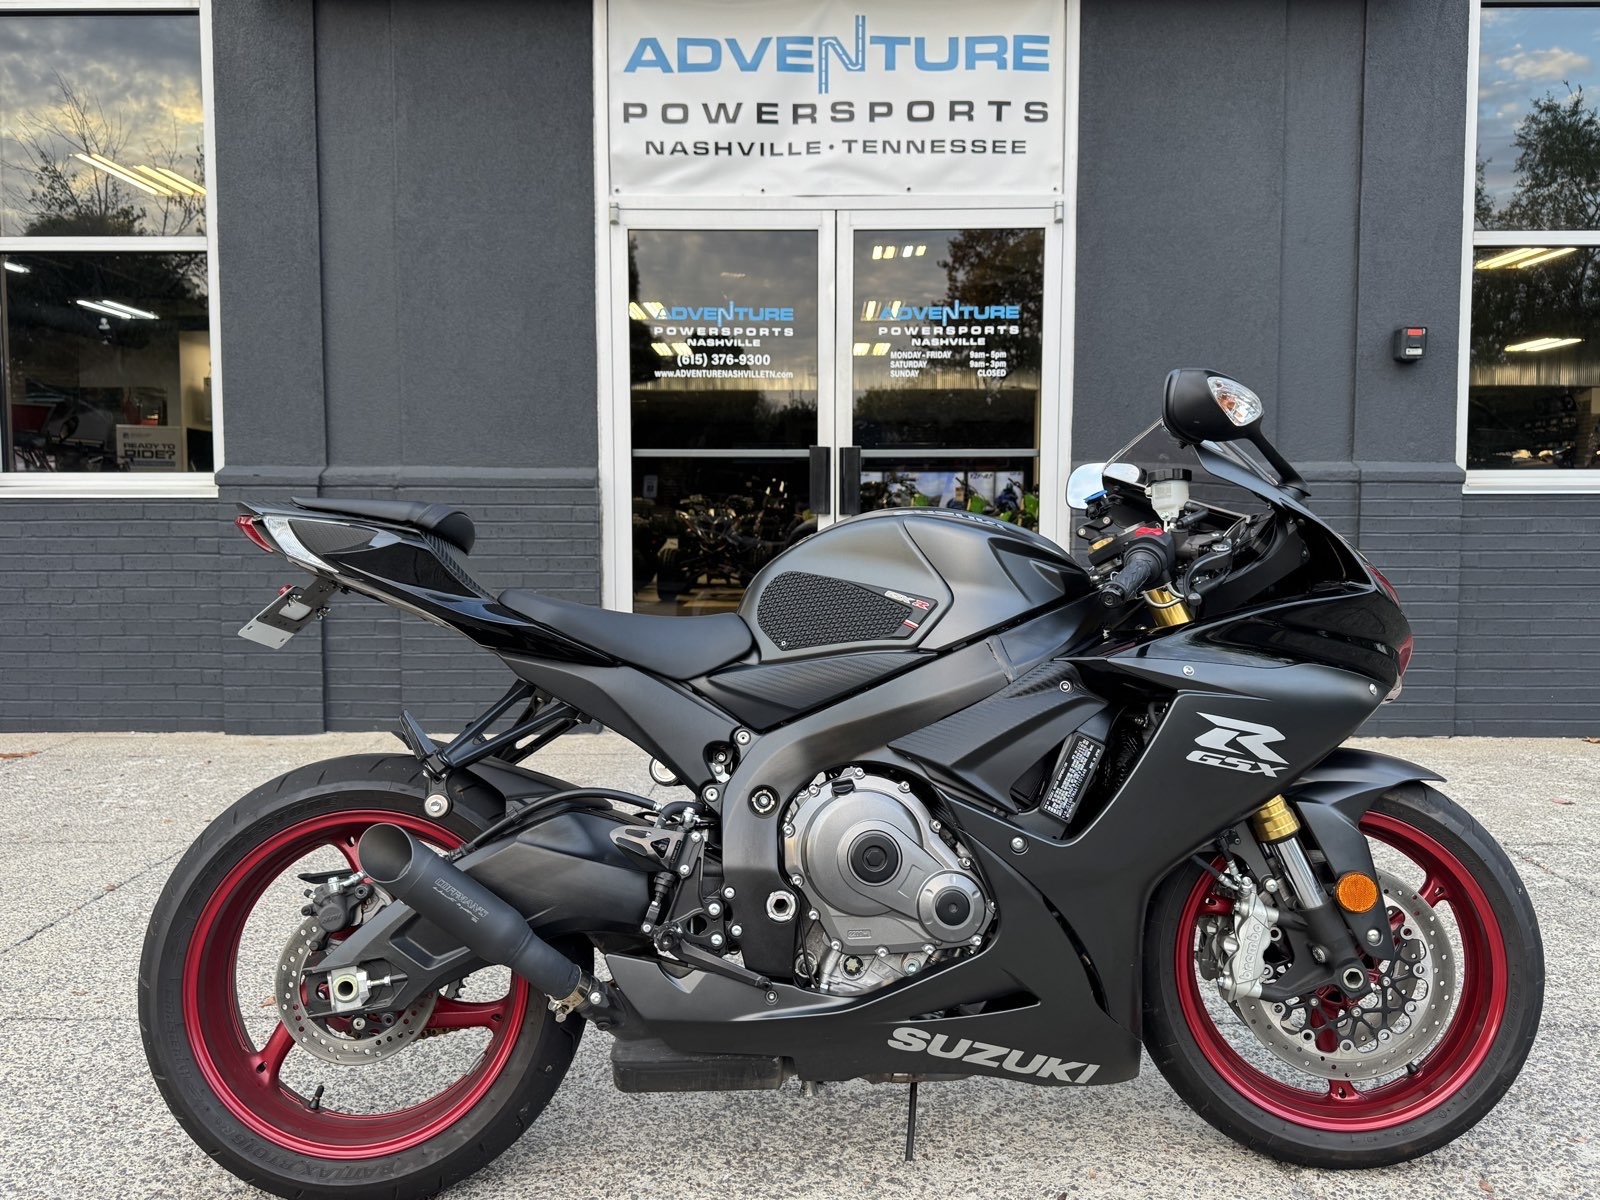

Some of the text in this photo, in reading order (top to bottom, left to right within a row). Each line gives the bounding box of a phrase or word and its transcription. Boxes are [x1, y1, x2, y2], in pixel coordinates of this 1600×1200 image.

[623, 15, 1050, 94] ADVENTURE
[623, 100, 1049, 125] POWERSPORTS
[645, 139, 1027, 157] NASHVILLE TENNESSEE
[656, 301, 794, 327] ADVENTURE
[879, 300, 1020, 326] ADVENTURE
[654, 327, 794, 337] POWERSPORTS
[878, 326, 1020, 336] POWERSPORTS
[687, 338, 761, 347] NASHVILLE
[911, 338, 986, 346] NASHVILLE
[676, 353, 771, 367] (615) 376-9300
[890, 351, 922, 359] MONDAY
[926, 351, 952, 359] FRIDAY
[890, 360, 928, 368] SATURDAY
[654, 369, 794, 380] www.ADVENTURENASHVILLETN.com
[890, 370, 920, 378] SUNDAY
[977, 369, 1007, 377] CLOSED
[124, 449, 176, 459] RIDE?
[1194, 711, 1290, 765] R
[1186, 750, 1289, 778] GSX
[1239, 922, 1263, 980] brembo
[887, 1026, 1101, 1085] SUZUKI
